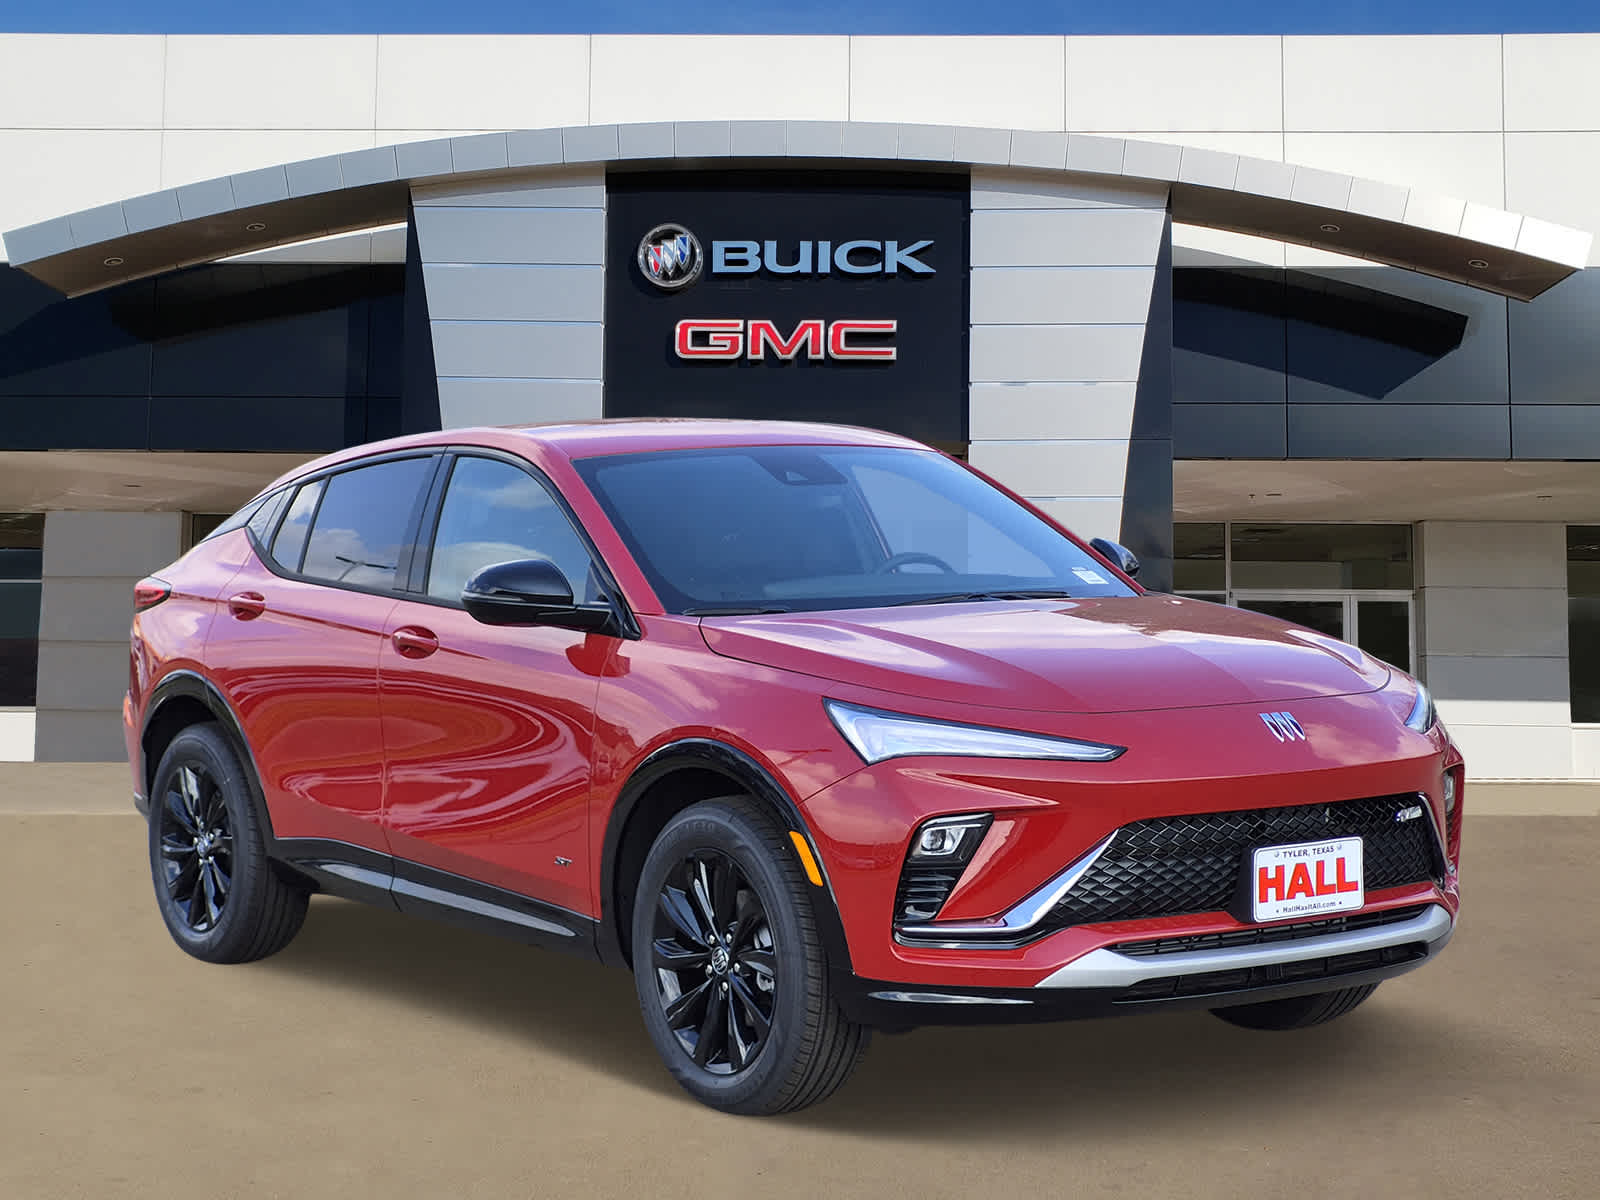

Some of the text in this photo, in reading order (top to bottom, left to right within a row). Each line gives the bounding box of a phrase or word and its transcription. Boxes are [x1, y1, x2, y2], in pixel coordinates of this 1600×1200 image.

[711, 240, 937, 274] BUICK
[674, 319, 898, 361] GMC
[1282, 845, 1335, 858] TYLER, TEXAS
[1258, 857, 1359, 904] HALL
